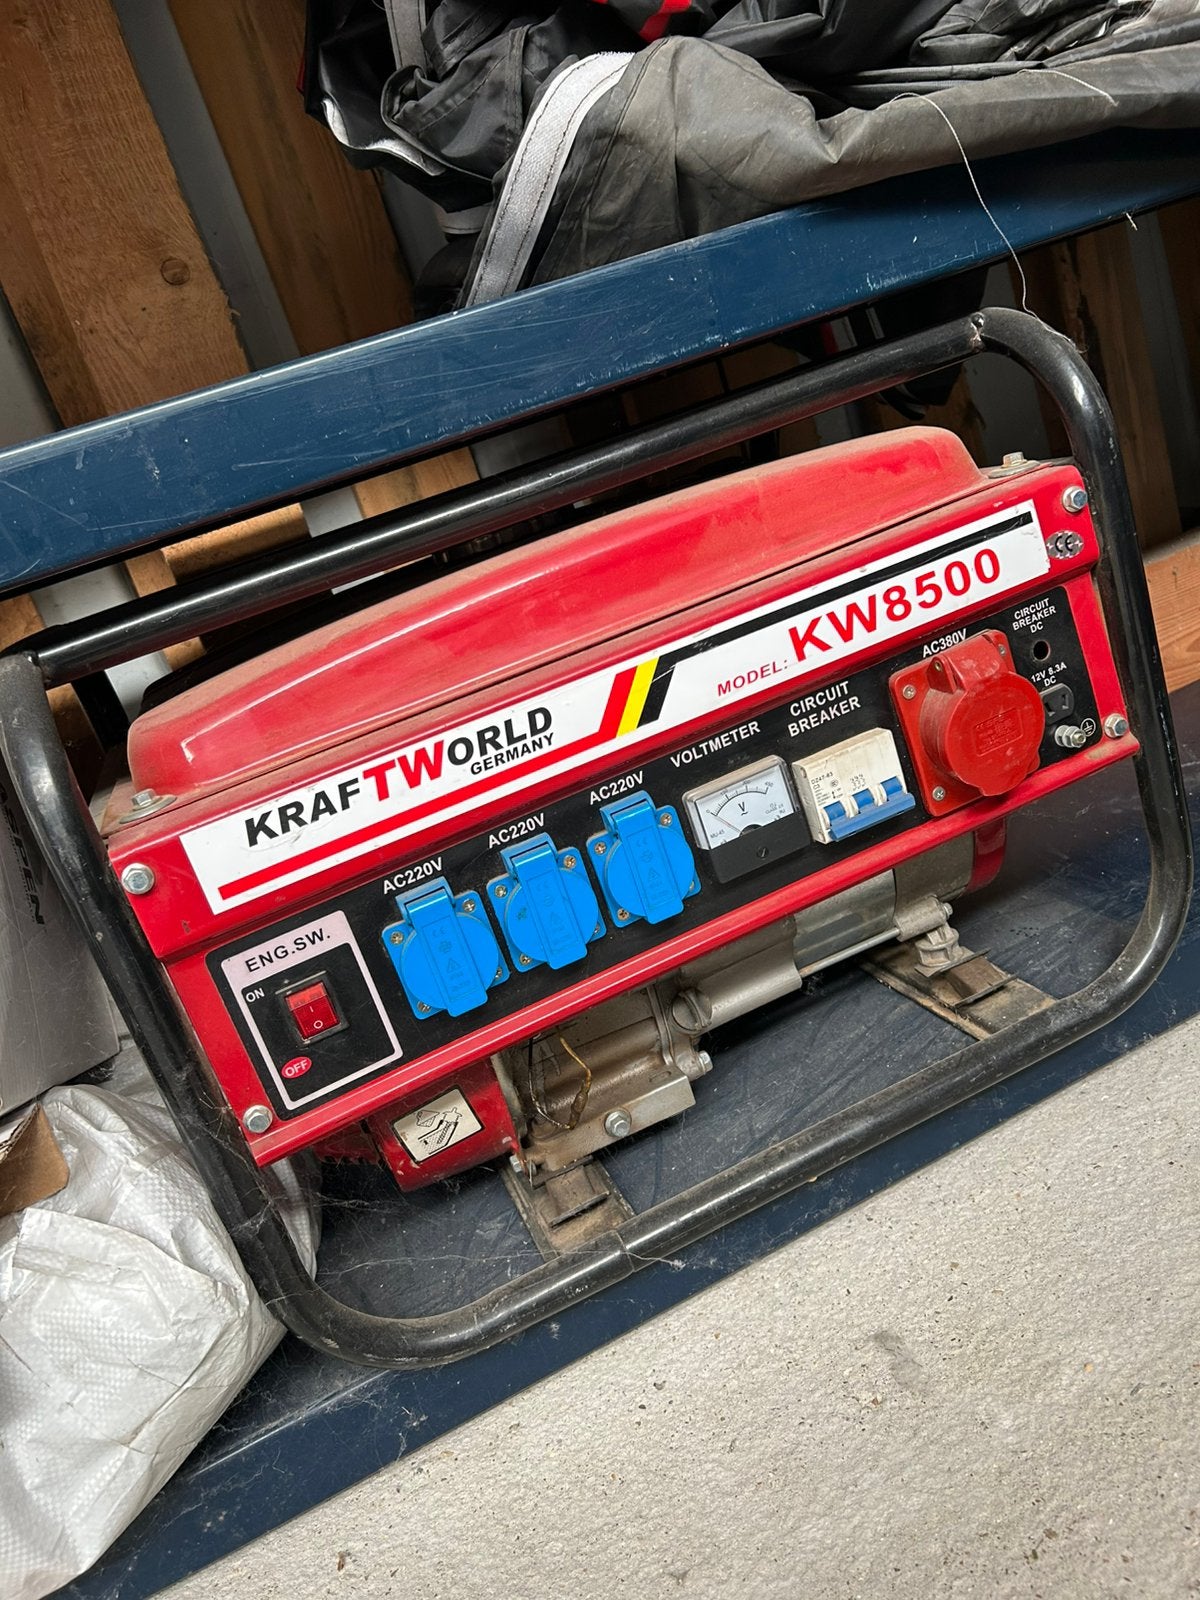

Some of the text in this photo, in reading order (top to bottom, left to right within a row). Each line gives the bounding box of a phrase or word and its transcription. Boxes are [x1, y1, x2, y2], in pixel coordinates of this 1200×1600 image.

[717, 548, 1000, 697] MODEL: KW8500
[1012, 606, 1056, 631] BREAKER
[1014, 598, 1050, 620] CIRCUIT
[922, 628, 967, 658] AC380V
[1030, 621, 1044, 634] DC
[1031, 661, 1067, 683] 12V 8.3A
[1044, 675, 1057, 687] DC
[790, 681, 849, 717] CIRCUIT
[788, 696, 861, 737] BREAKER
[470, 732, 554, 775] GERMANY
[670, 721, 761, 768] VOLTMETER
[244, 706, 552, 847] KRAFTWORLD
[589, 771, 645, 805] AC220V
[738, 801, 745, 812] V
[488, 813, 545, 849] AC220V
[383, 857, 443, 894] AC220V
[245, 928, 331, 973] ENG.SW.
[245, 987, 265, 1003] ON
[284, 1060, 309, 1077] OFF
